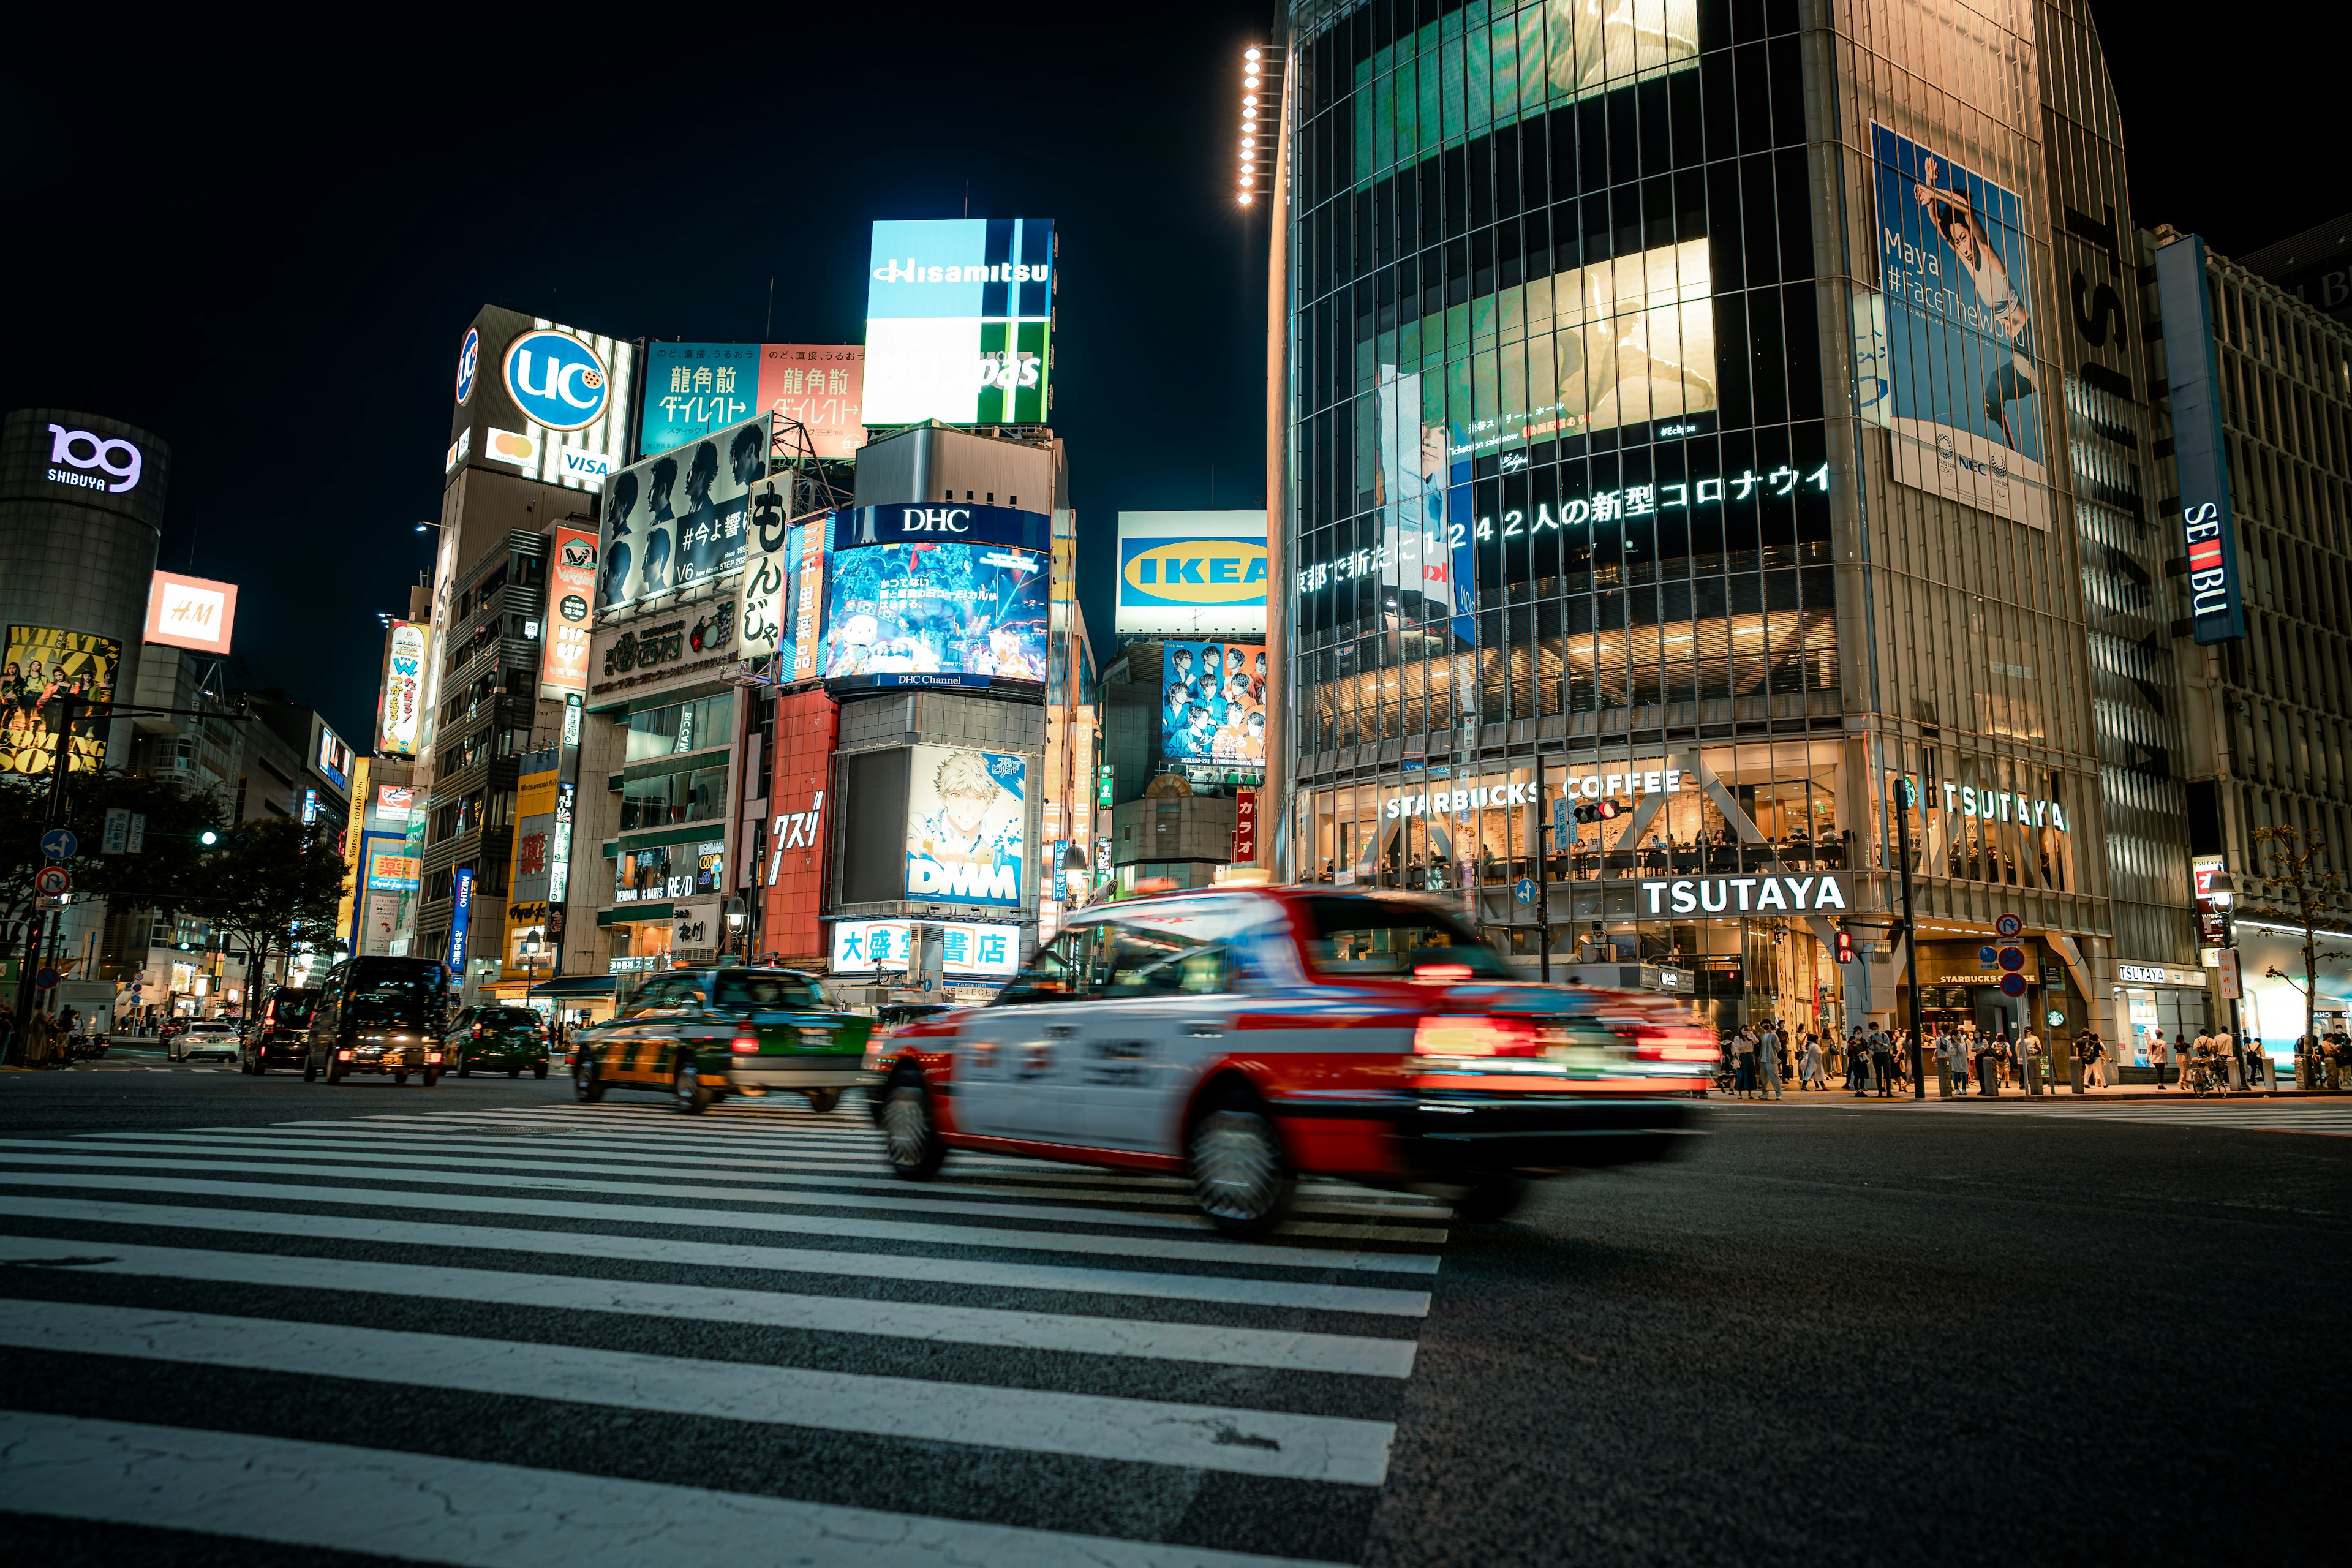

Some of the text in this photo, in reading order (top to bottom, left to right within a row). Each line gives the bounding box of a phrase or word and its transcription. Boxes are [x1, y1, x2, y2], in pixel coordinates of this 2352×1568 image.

[1885, 228, 1939, 276] Maya
[872, 258, 1049, 284] Hisamitsu
[657, 349, 754, 360] のど、直接、うるおう
[769, 350, 865, 361] のど、直接、うるおう
[670, 366, 737, 394] 龍角散
[783, 368, 849, 396] 龍角散
[658, 396, 747, 424] ダイレクト
[772, 398, 859, 425] ダイレクト
[845, 440, 862, 450] 生薬
[1502, 433, 1518, 442] now
[48, 423, 142, 493] 109
[565, 453, 608, 475] VISA
[1959, 456, 1986, 477] NEC
[48, 469, 105, 491] SHIBUYA
[902, 509, 970, 532] DHC
[677, 562, 694, 582] V6
[706, 566, 718, 575] Album
[720, 559, 735, 570] STEP
[739, 481, 786, 649] もんじゃ
[2184, 502, 2228, 619] SEIBU
[880, 578, 929, 589] かつてない
[172, 600, 214, 625] H&M
[637, 631, 682, 668] 西村
[899, 676, 961, 685] DHC Channel
[328, 765, 345, 790] SHIBUYA
[520, 781, 549, 792] Matsumoto
[1387, 769, 1680, 819] STARBUCKS COFFEE
[1943, 782, 2067, 832] TSUTAYA
[112, 813, 126, 851] 渋谷駅前
[131, 816, 142, 851] スクランブル式
[349, 812, 361, 858] Matsumoto
[379, 858, 402, 876] 薬
[520, 834, 548, 875] 薬
[642, 889, 646, 900] &
[647, 887, 663, 900] DARTS
[667, 875, 693, 898] RE/D
[908, 858, 1017, 899] DMM
[459, 876, 470, 908] MIZUHO
[1642, 876, 1845, 913] TSUTAYA
[679, 921, 704, 942] 松川
[452, 930, 463, 965] みずほ銀行
[2120, 967, 2164, 982] TSUTAYA
[2220, 953, 2231, 995] 公園通り
